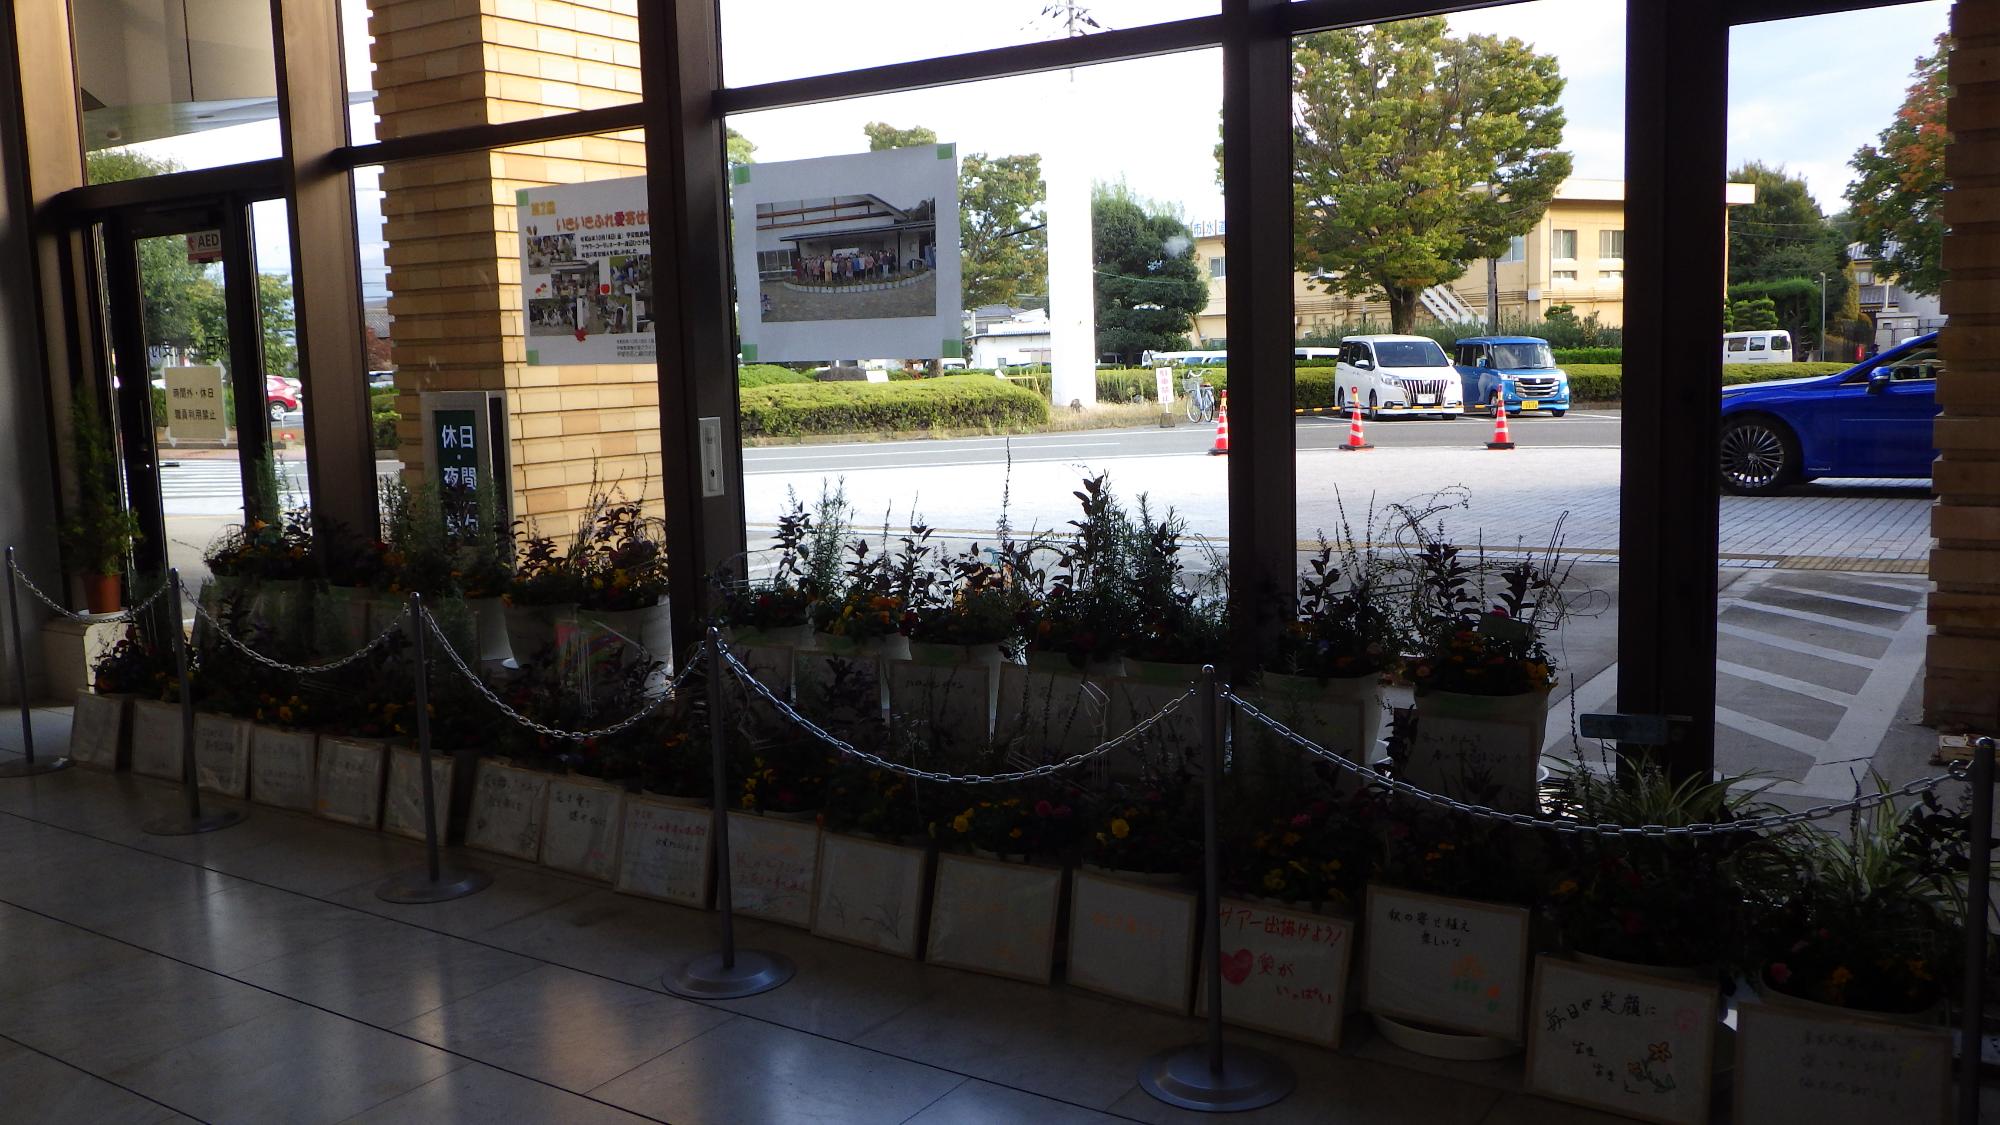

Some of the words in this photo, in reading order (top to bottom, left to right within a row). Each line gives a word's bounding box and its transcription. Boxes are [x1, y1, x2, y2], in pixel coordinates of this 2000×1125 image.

[556, 210, 650, 232] いきいきふれ愛寄せ
[198, 234, 219, 248] AED
[441, 424, 474, 449] 休日
[443, 466, 477, 490] 夜間
